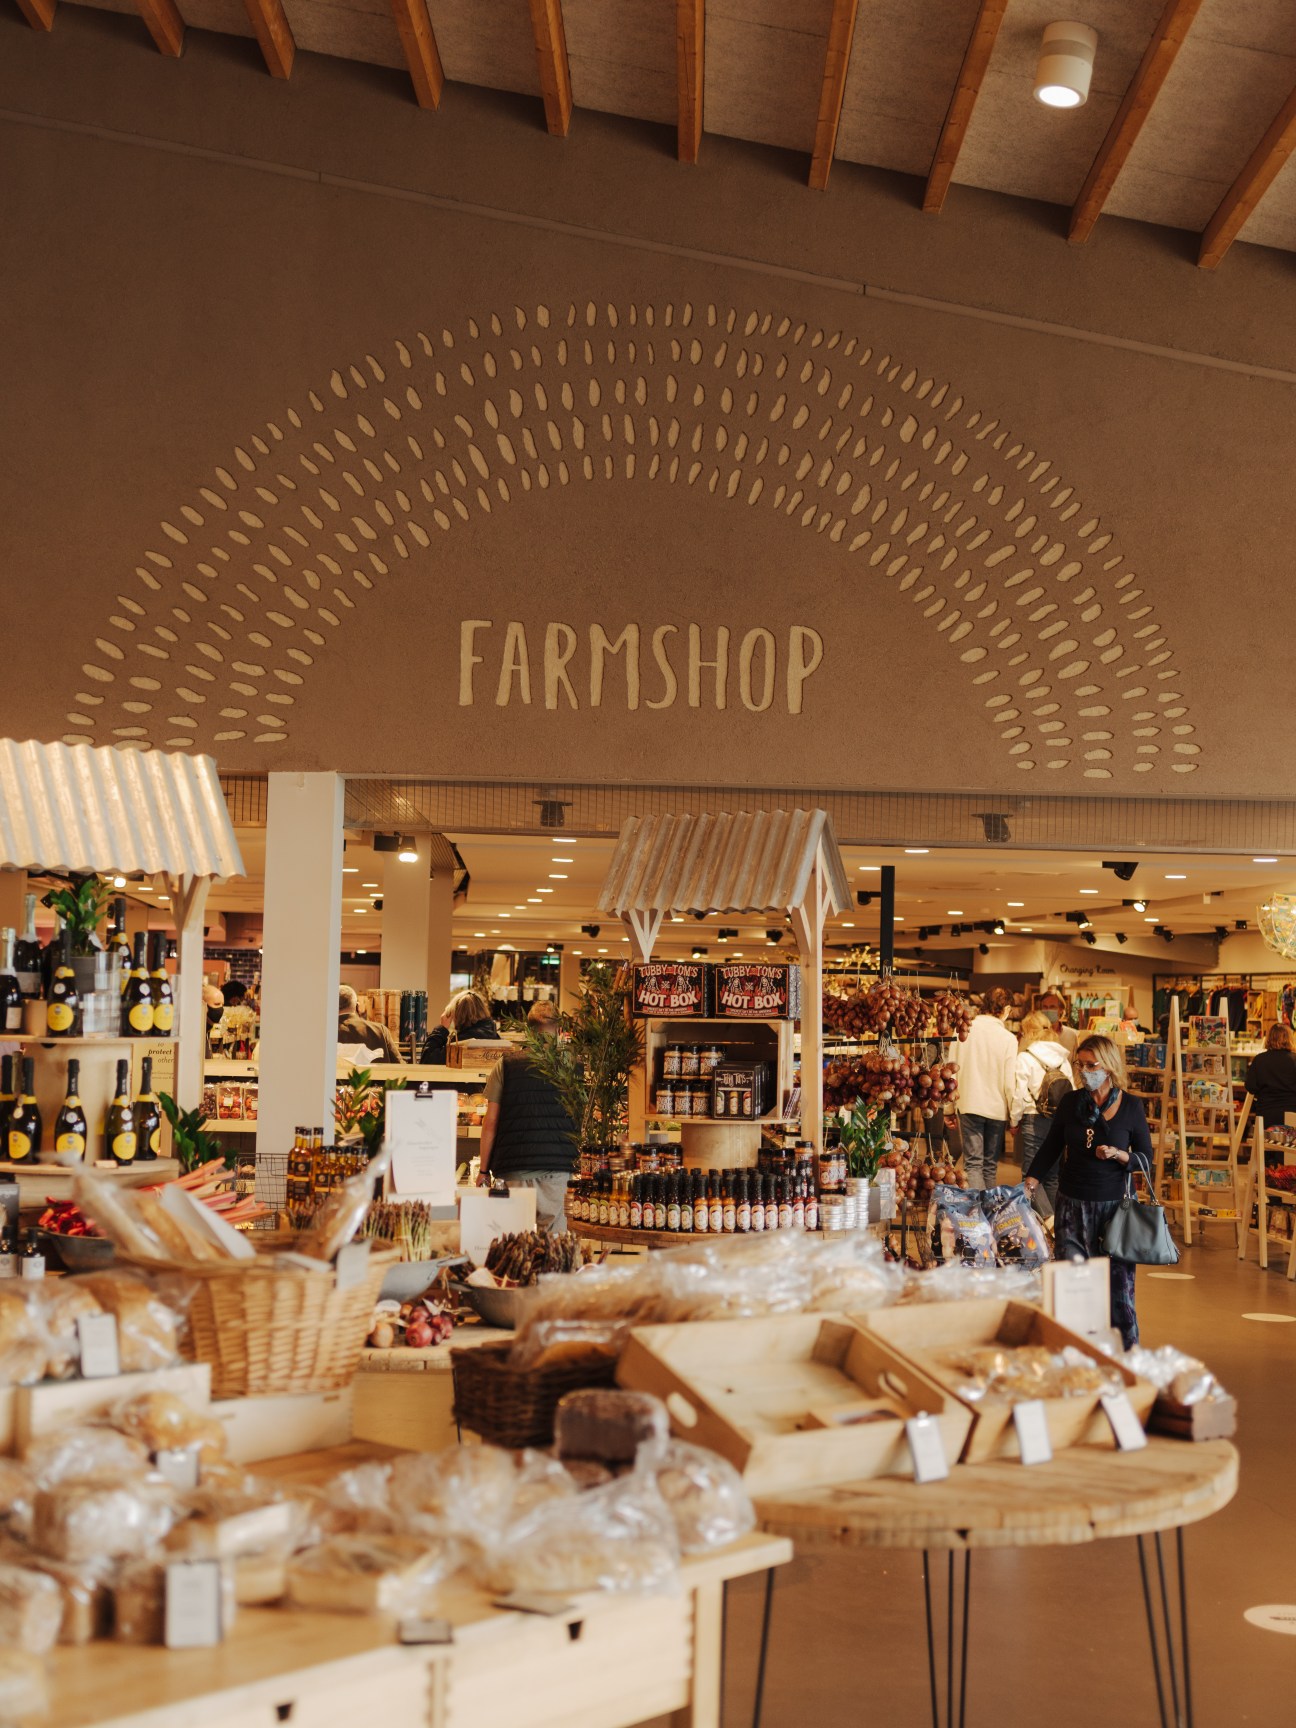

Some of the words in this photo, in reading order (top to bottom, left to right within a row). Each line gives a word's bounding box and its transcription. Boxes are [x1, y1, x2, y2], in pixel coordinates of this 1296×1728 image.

[458, 619, 825, 715] FARMSHOP
[639, 965, 667, 977] TUBBY
[672, 965, 698, 977] TOM'S
[721, 966, 751, 979] TUBBY
[755, 966, 783, 979] TOM'S
[1060, 963, 1093, 977] Changing
[638, 989, 666, 1007] HOT
[670, 989, 699, 1008] BOX
[721, 991, 750, 1009] HOT
[754, 991, 783, 1009] BOX
[148, 1049, 172, 1057] protect
